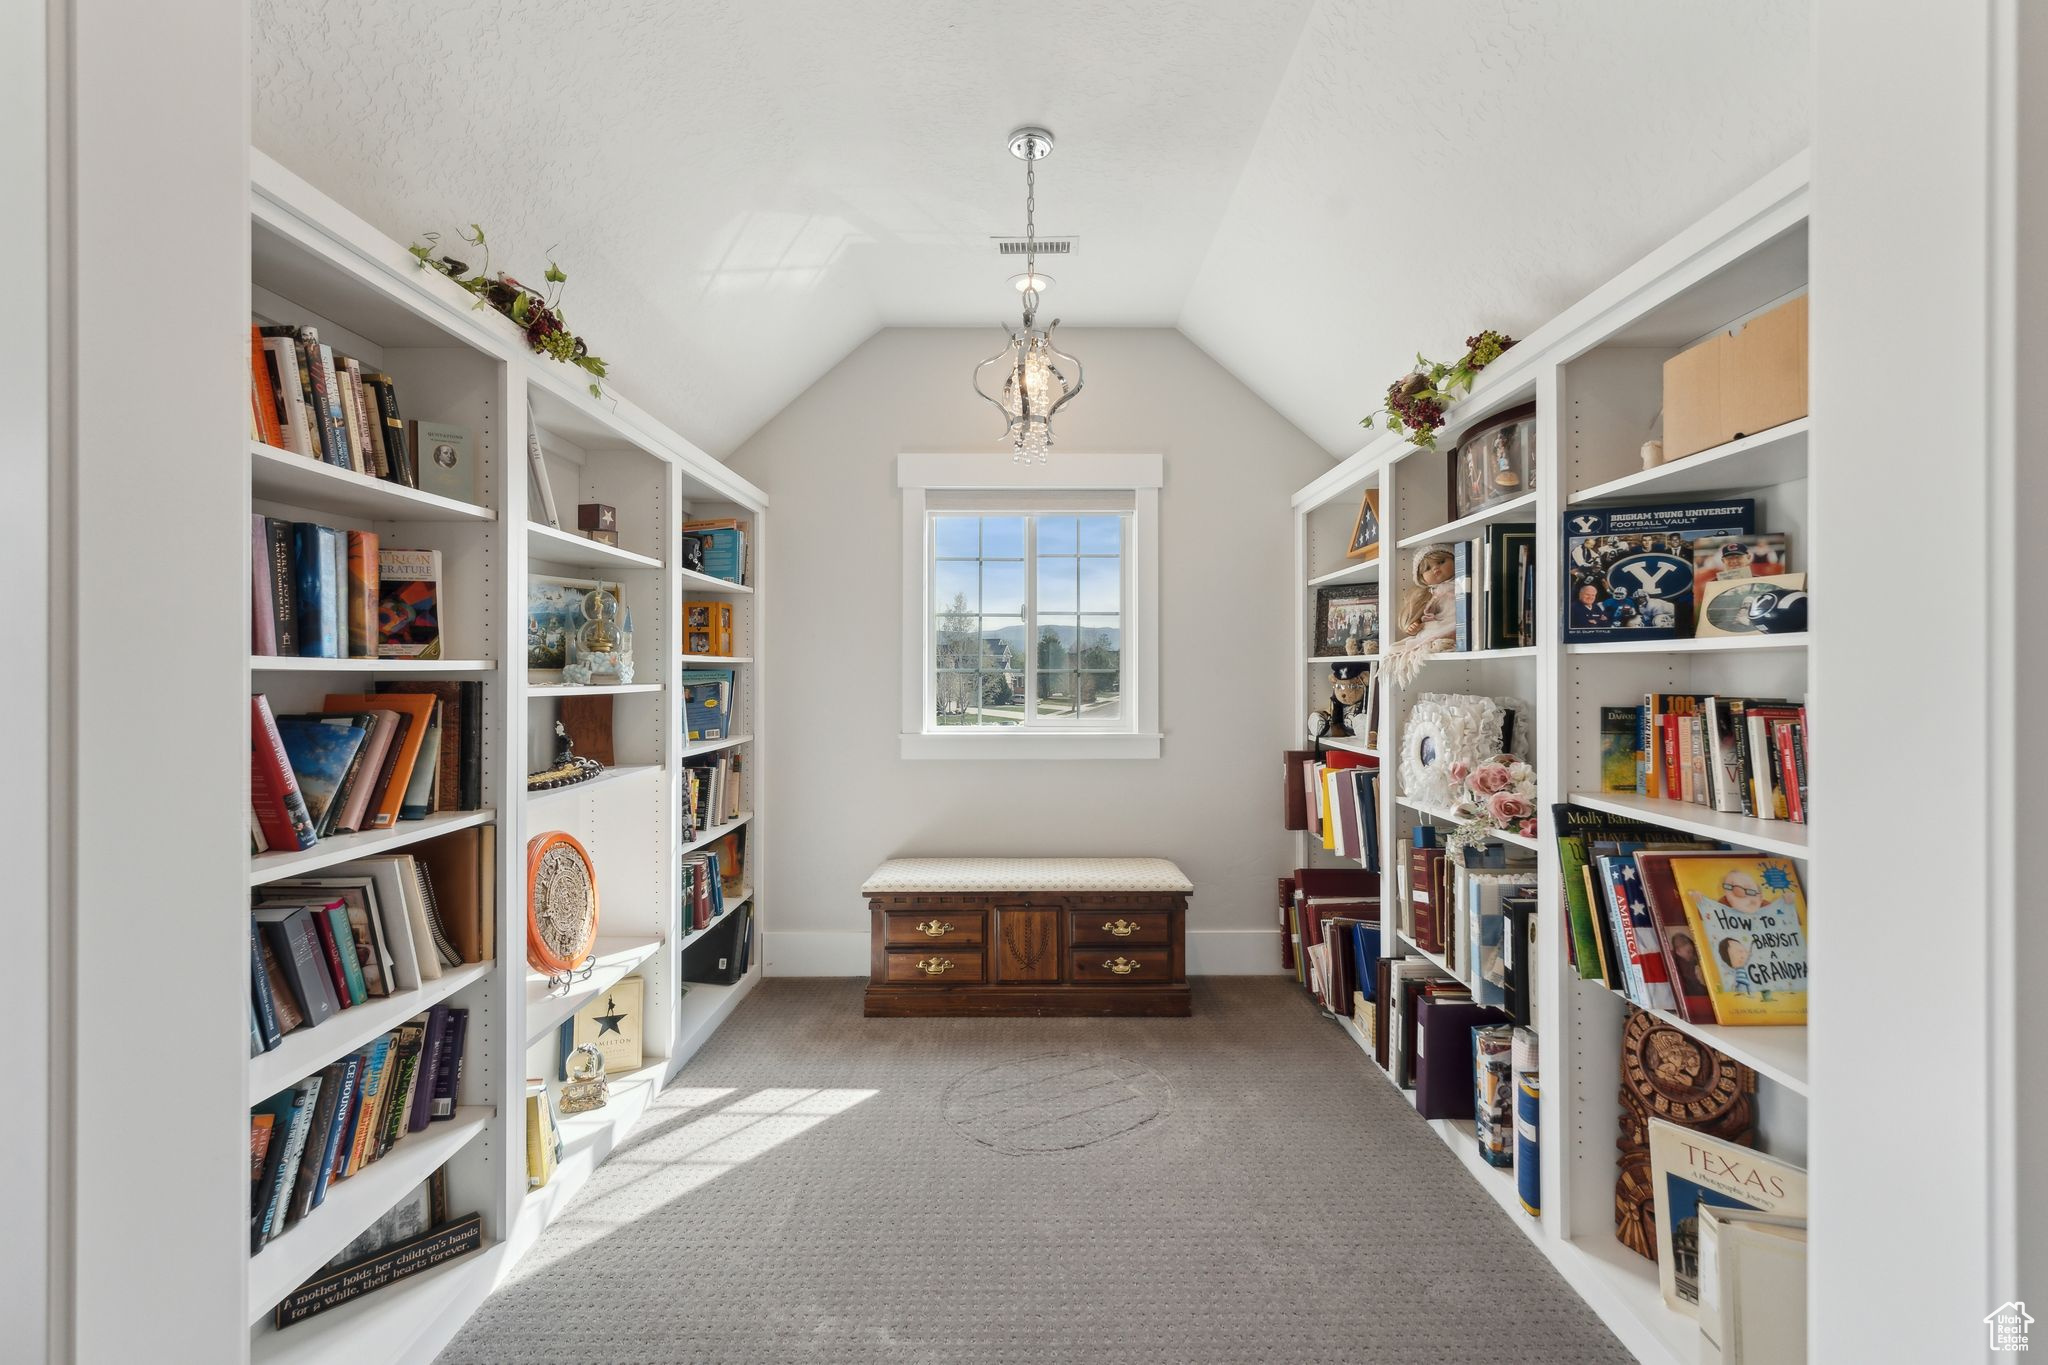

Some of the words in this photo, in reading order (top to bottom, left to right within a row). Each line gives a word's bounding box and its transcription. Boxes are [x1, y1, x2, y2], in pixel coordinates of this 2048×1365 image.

[1610, 512, 1652, 522] BRIGHAM
[1653, 510, 1684, 519] YOUNG
[1685, 506, 1744, 517] UNIVERSITY
[1610, 520, 1662, 528] FOOTBALL
[380, 554, 432, 564] ERICAN
[1622, 561, 1678, 594] Y
[1666, 696, 1695, 714] 100
[274, 746, 294, 790] PROPHETS
[1568, 812, 1602, 826] Molly
[1597, 832, 1626, 842] HAVE
[1645, 832, 1689, 842] DREAM
[1617, 895, 1636, 960] AMERICA
[1752, 932, 1799, 949] BABYSIT
[1770, 950, 1778, 959] A
[346, 1061, 357, 1081] ICE
[338, 1080, 354, 1121] BOUND
[254, 1129, 269, 1169] KRISTIN
[274, 1162, 287, 1184] CITY
[1681, 1142, 1784, 1198] TEXAS
[261, 1206, 274, 1233] DEAD
[284, 1300, 292, 1310] A
[296, 1282, 338, 1305] mother
[343, 1269, 372, 1286] holds
[375, 1260, 393, 1275] her
[396, 1239, 446, 1265] children's
[450, 1226, 478, 1244] hands
[292, 1306, 308, 1320] for
[364, 1274, 389, 1290] their
[393, 1258, 426, 1278] hearts
[430, 1242, 470, 1263] forever.
